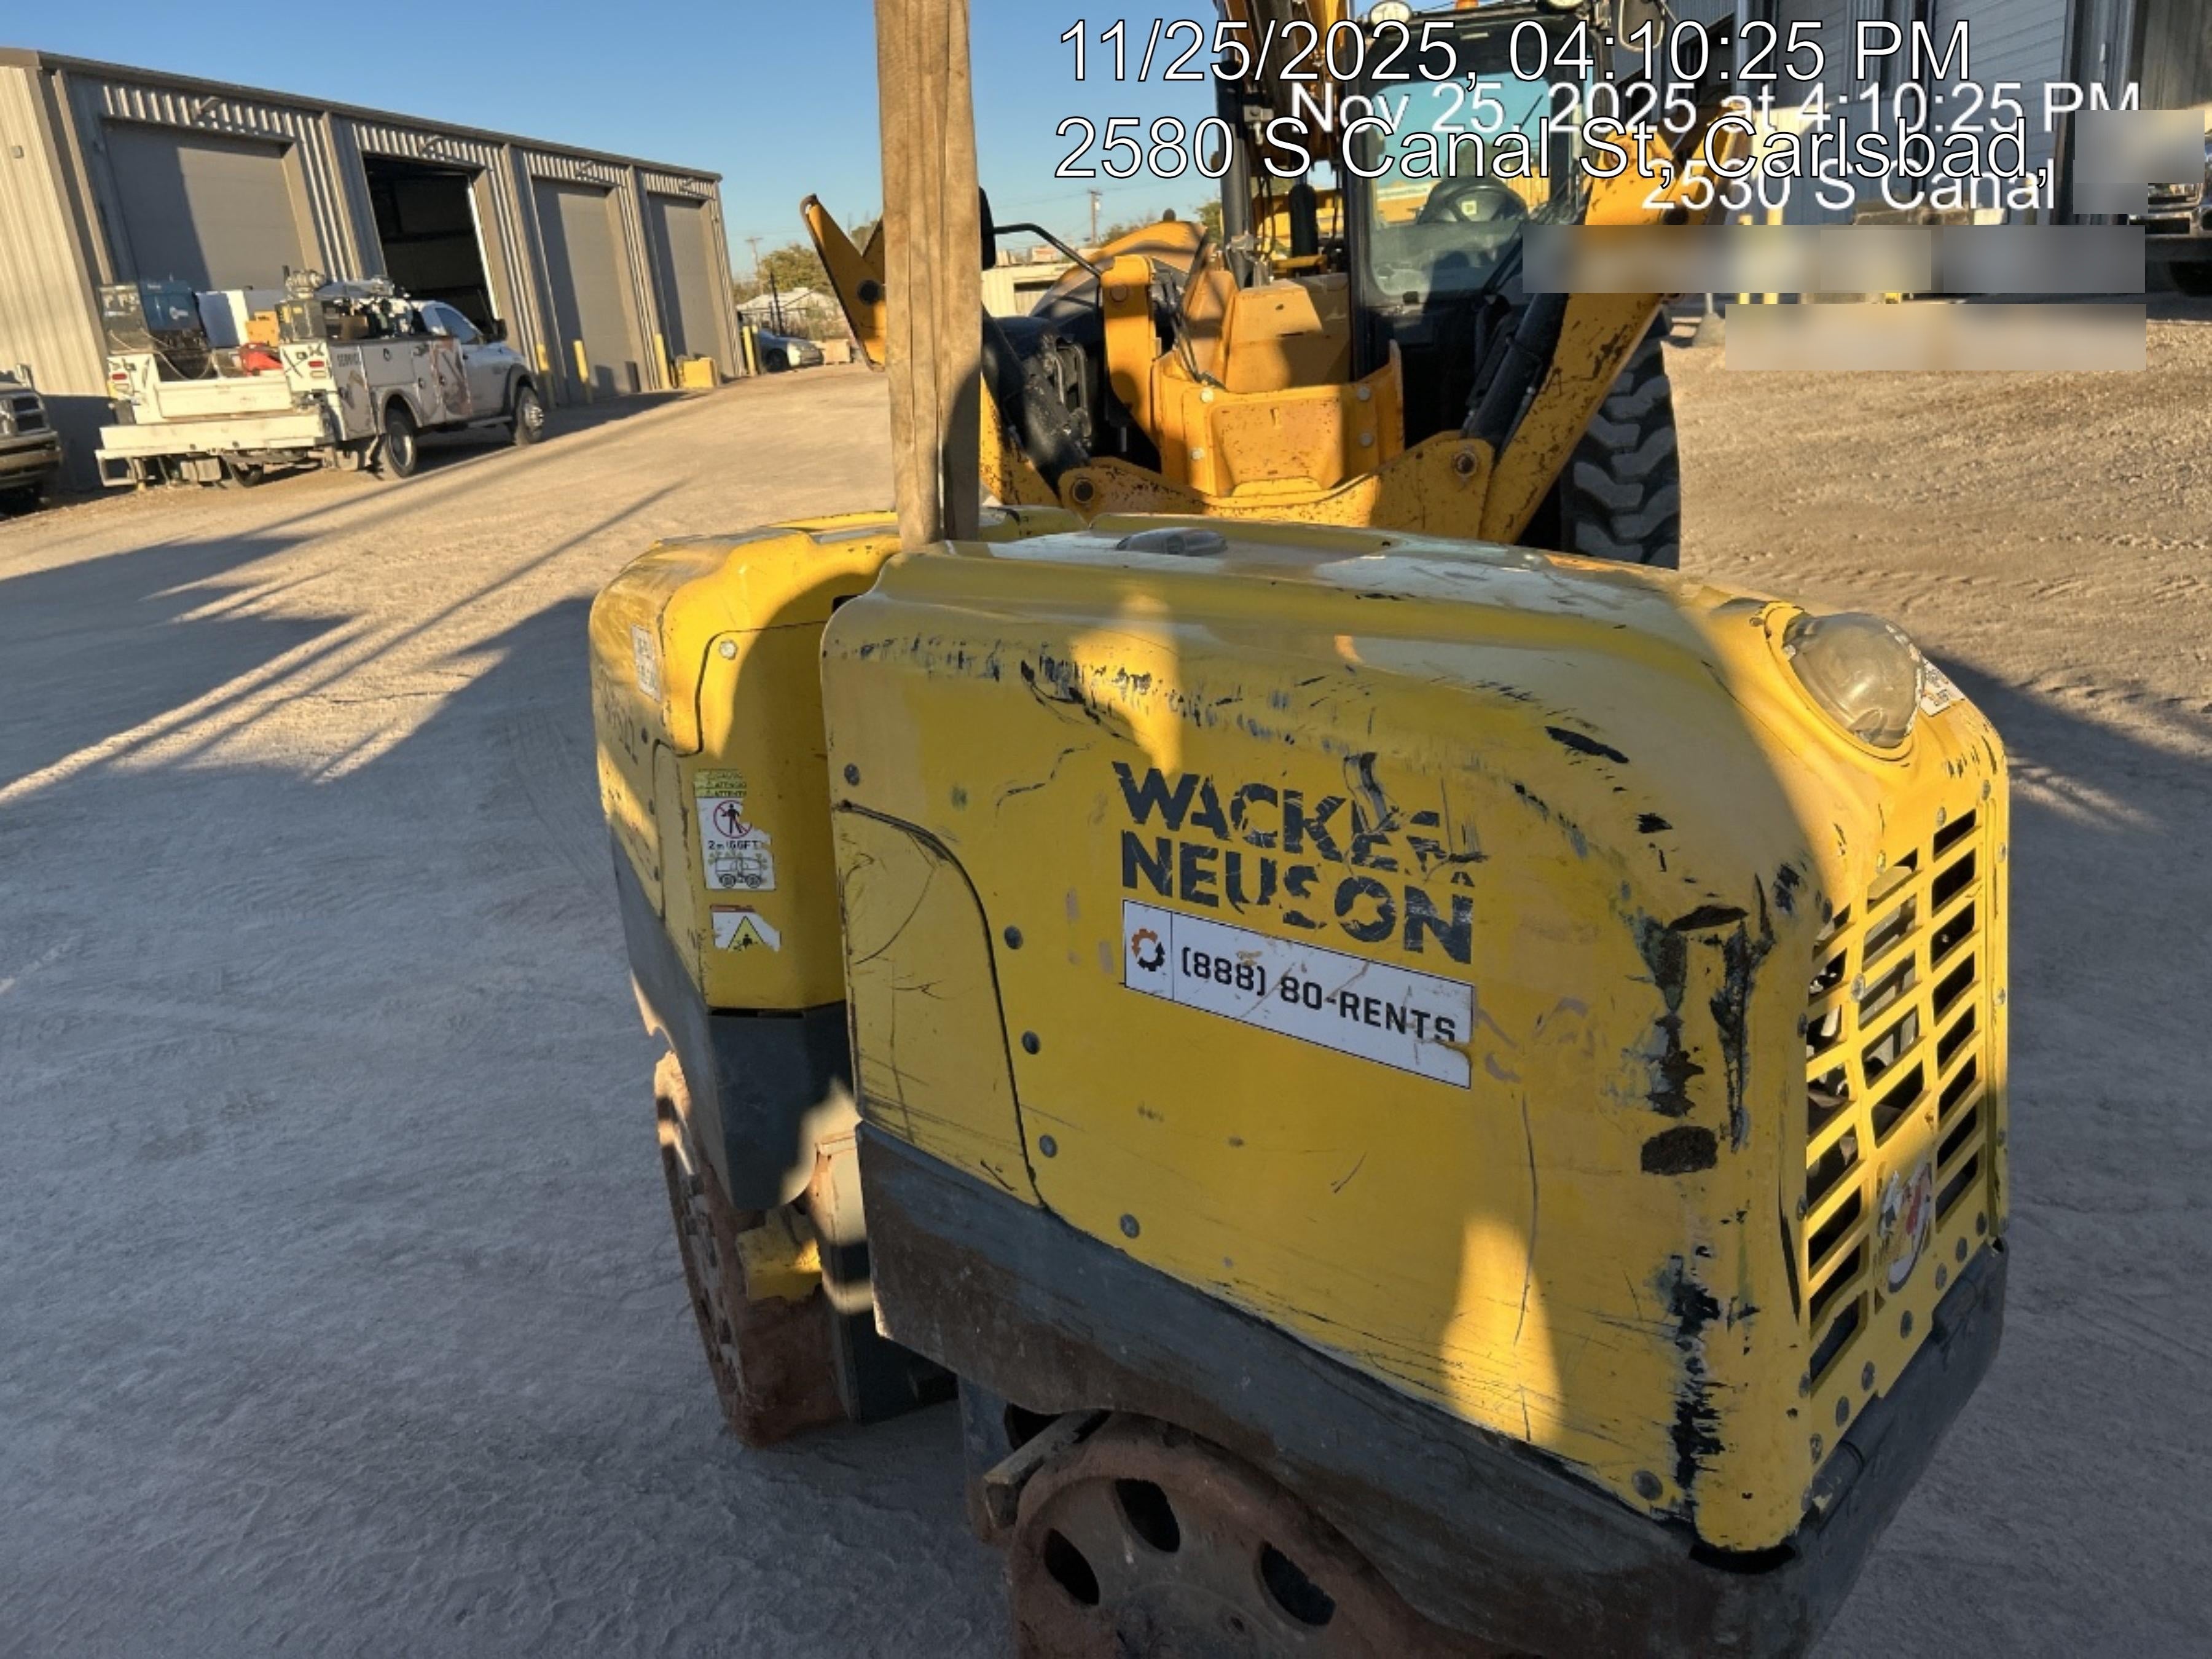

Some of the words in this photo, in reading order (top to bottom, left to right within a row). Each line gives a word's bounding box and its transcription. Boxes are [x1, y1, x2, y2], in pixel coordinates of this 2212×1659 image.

[1121, 830, 1474, 965] NEUSON
[1182, 946, 1266, 997] (888)
[1280, 976, 1456, 1043] 80-RENTS
